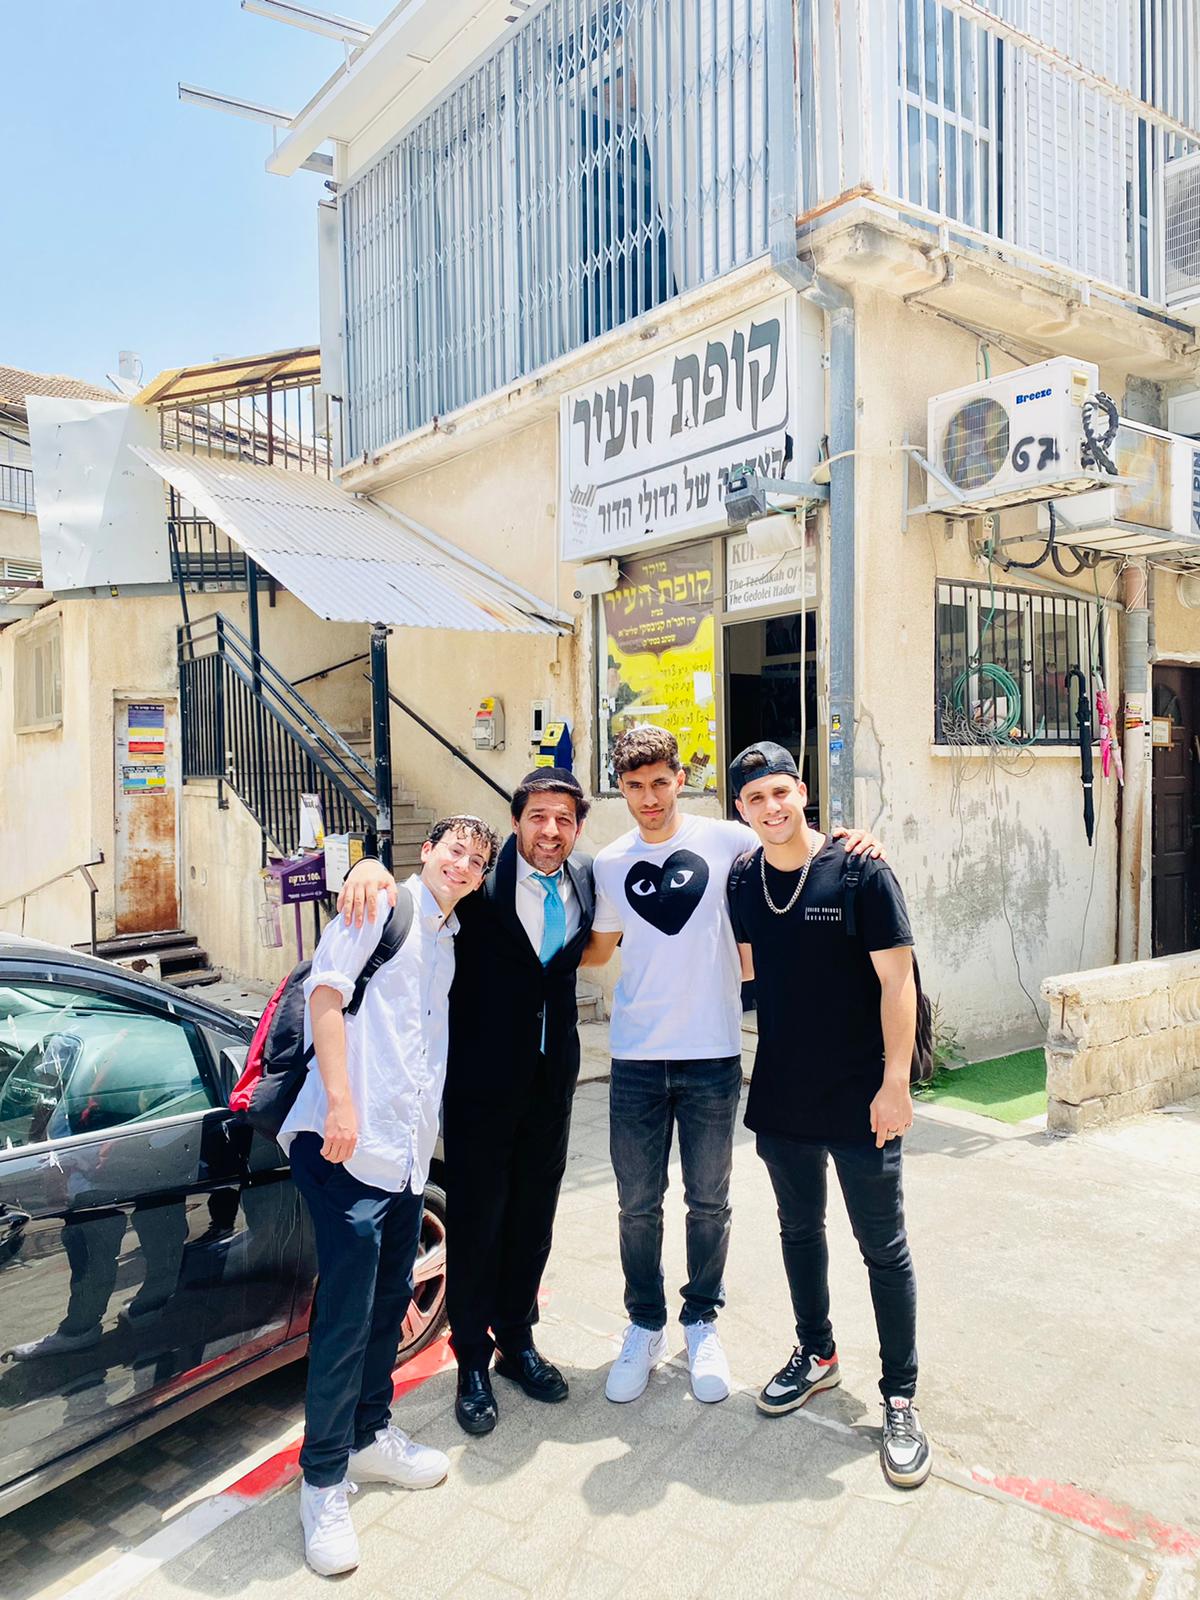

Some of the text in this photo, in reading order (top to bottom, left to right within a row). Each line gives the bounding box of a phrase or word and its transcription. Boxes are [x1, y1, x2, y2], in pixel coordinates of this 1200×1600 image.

[573, 318, 780, 467] קופת העיר
[1016, 388, 1052, 404] Breeze
[1012, 436, 1060, 472] 67
[638, 478, 678, 524] גדולי
[683, 465, 711, 512] של
[598, 497, 632, 535] הדור
[605, 570, 711, 615] קופת העיר
[729, 579, 744, 590] The
[729, 583, 797, 605] The Gedolei Hador
